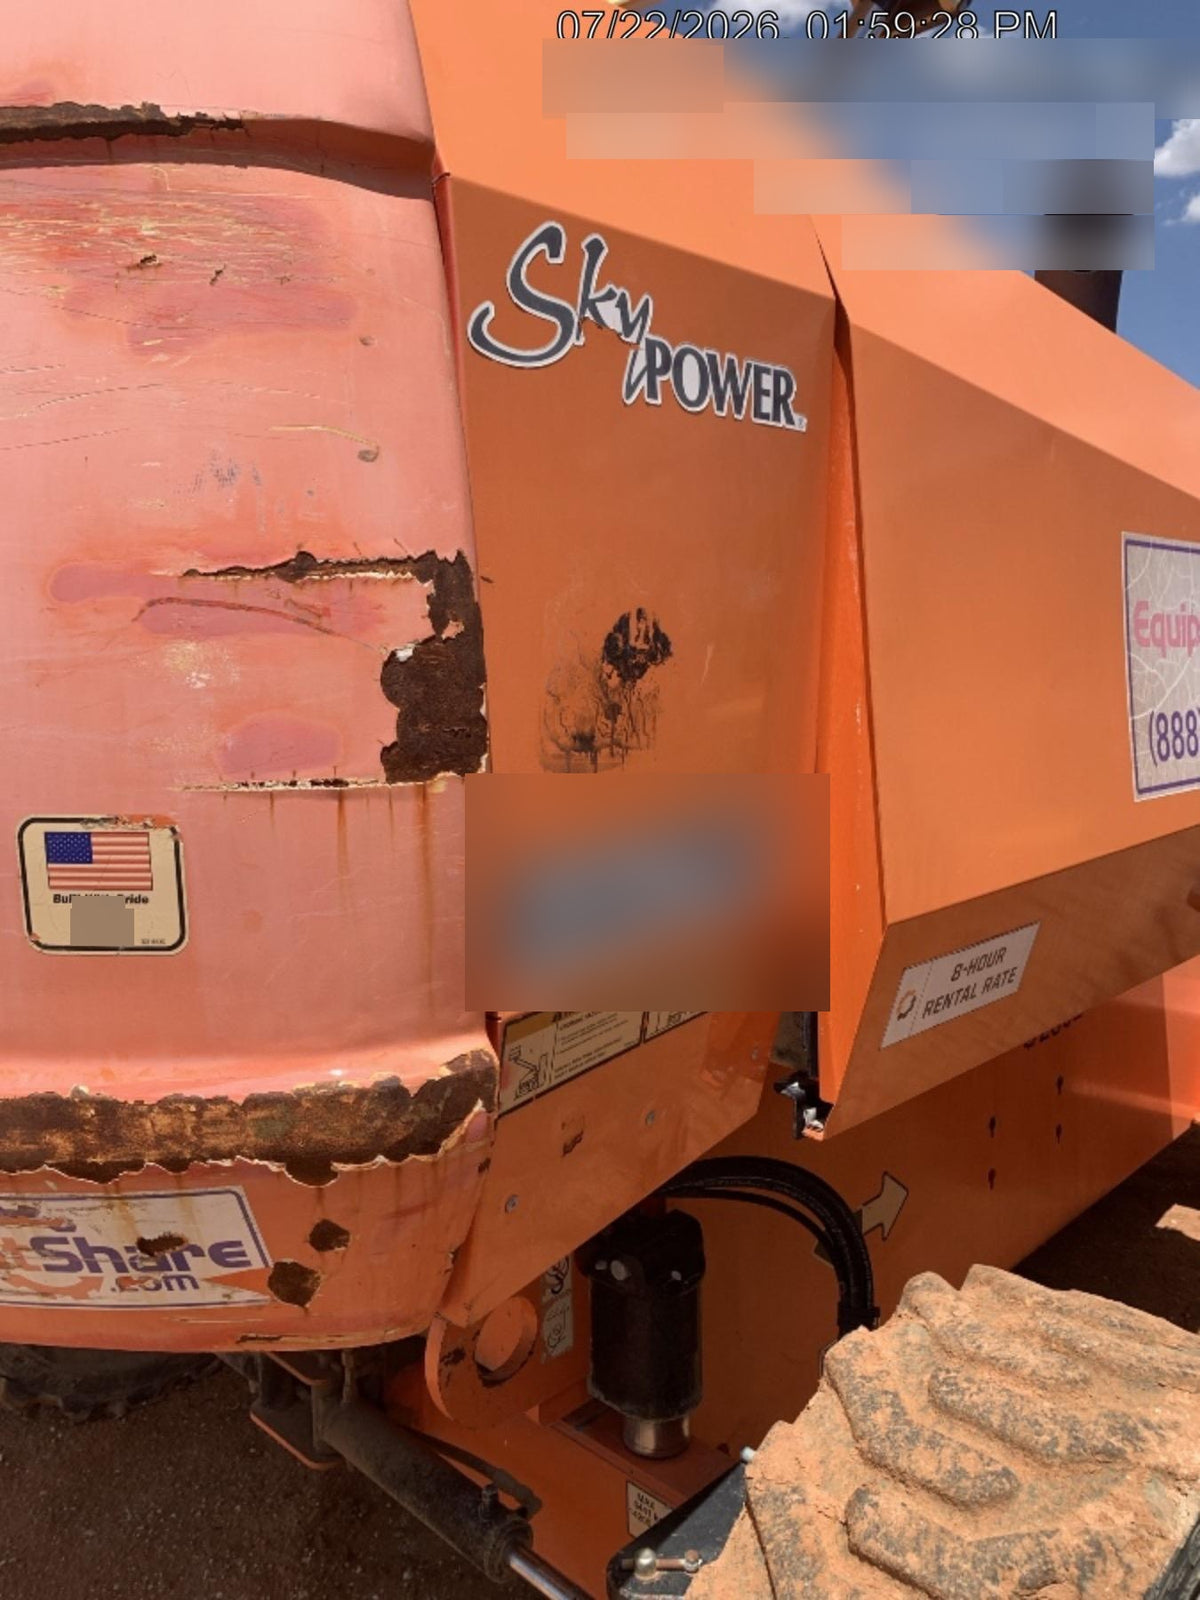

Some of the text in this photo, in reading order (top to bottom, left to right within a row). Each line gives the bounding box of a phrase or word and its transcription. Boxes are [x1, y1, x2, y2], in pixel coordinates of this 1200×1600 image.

[468, 222, 652, 404] Sky
[643, 336, 797, 428] POWER
[1149, 706, 1200, 768] (888
[922, 966, 1018, 1019] RENTAL RATE
[951, 947, 1007, 982] 8-HOUR
